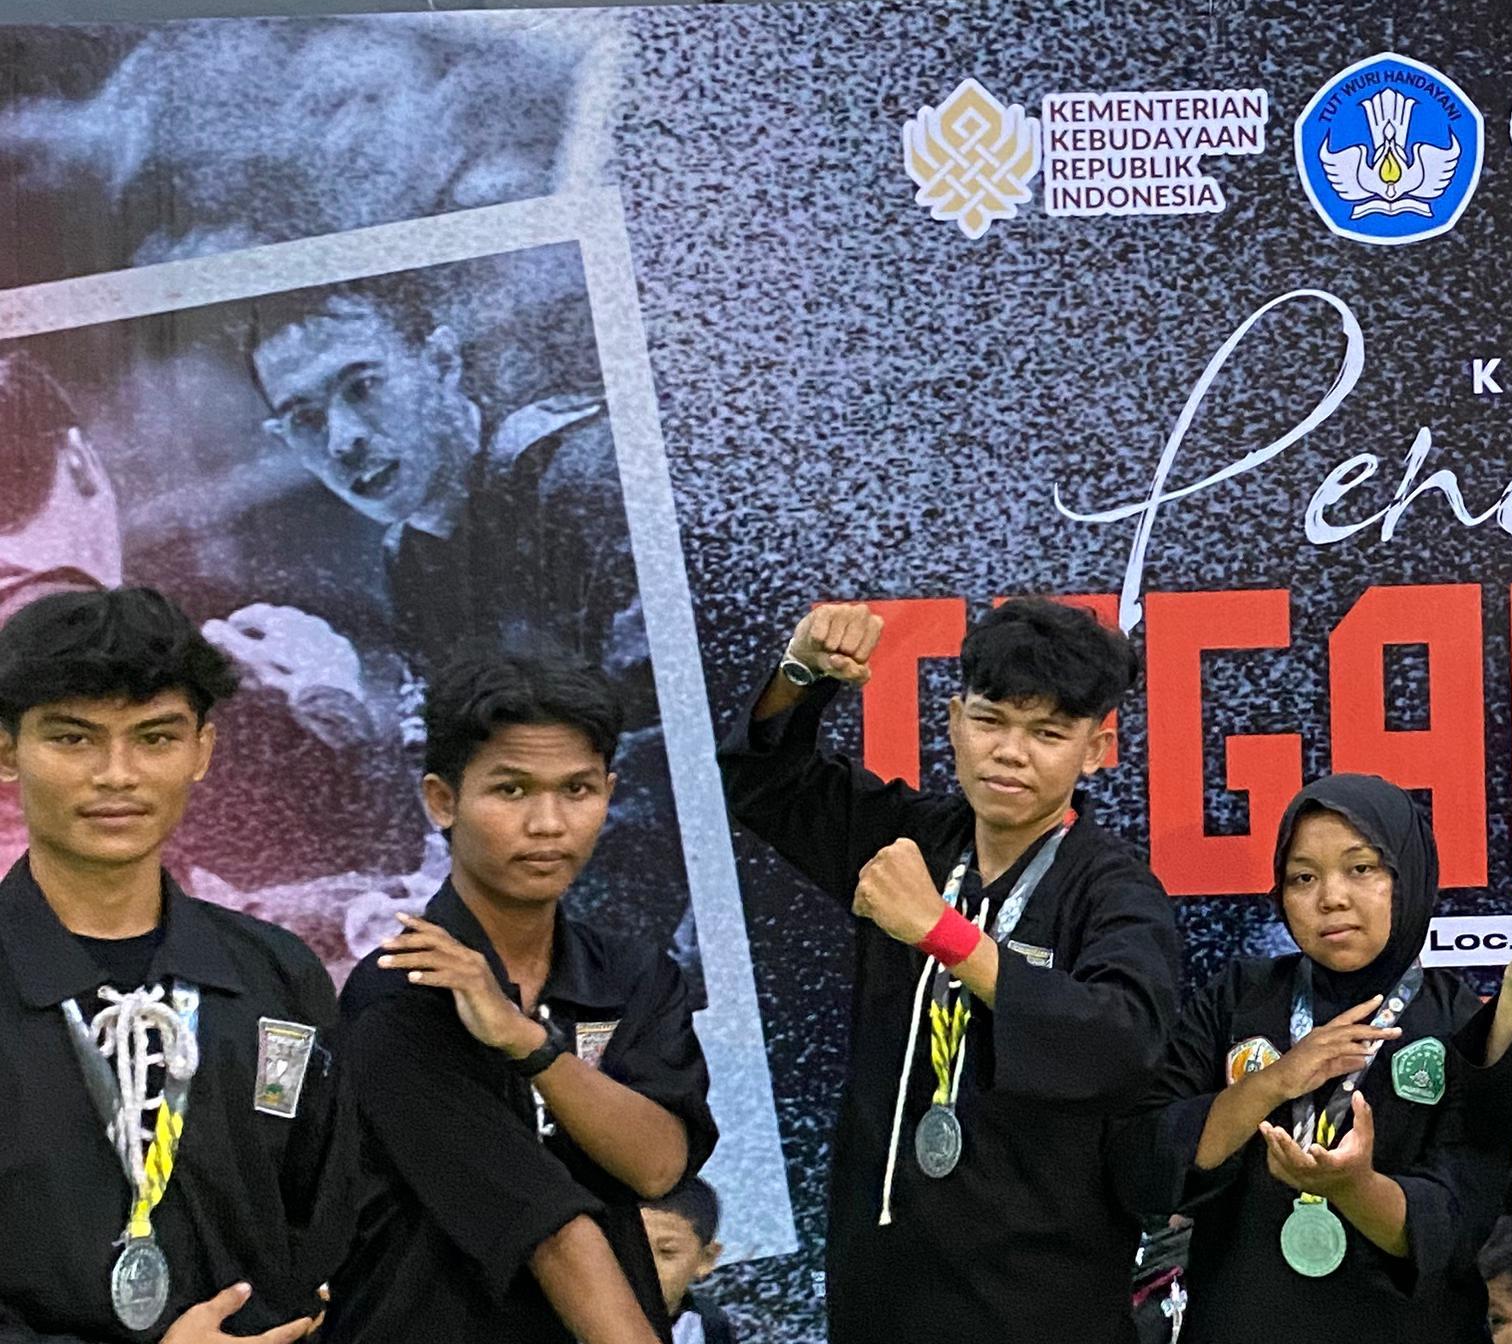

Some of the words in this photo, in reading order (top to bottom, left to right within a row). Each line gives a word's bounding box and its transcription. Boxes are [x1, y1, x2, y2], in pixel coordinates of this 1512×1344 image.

[1050, 96, 1262, 122] KEMENTERIAN
[1318, 93, 1342, 123] TUT
[1341, 71, 1381, 97] WURI
[1384, 70, 1462, 122] HANDAYANI
[1051, 125, 1258, 151] KEBUDAYAAN
[1052, 156, 1194, 180] REPUBLIK
[1052, 184, 1218, 209] INDONESIA
